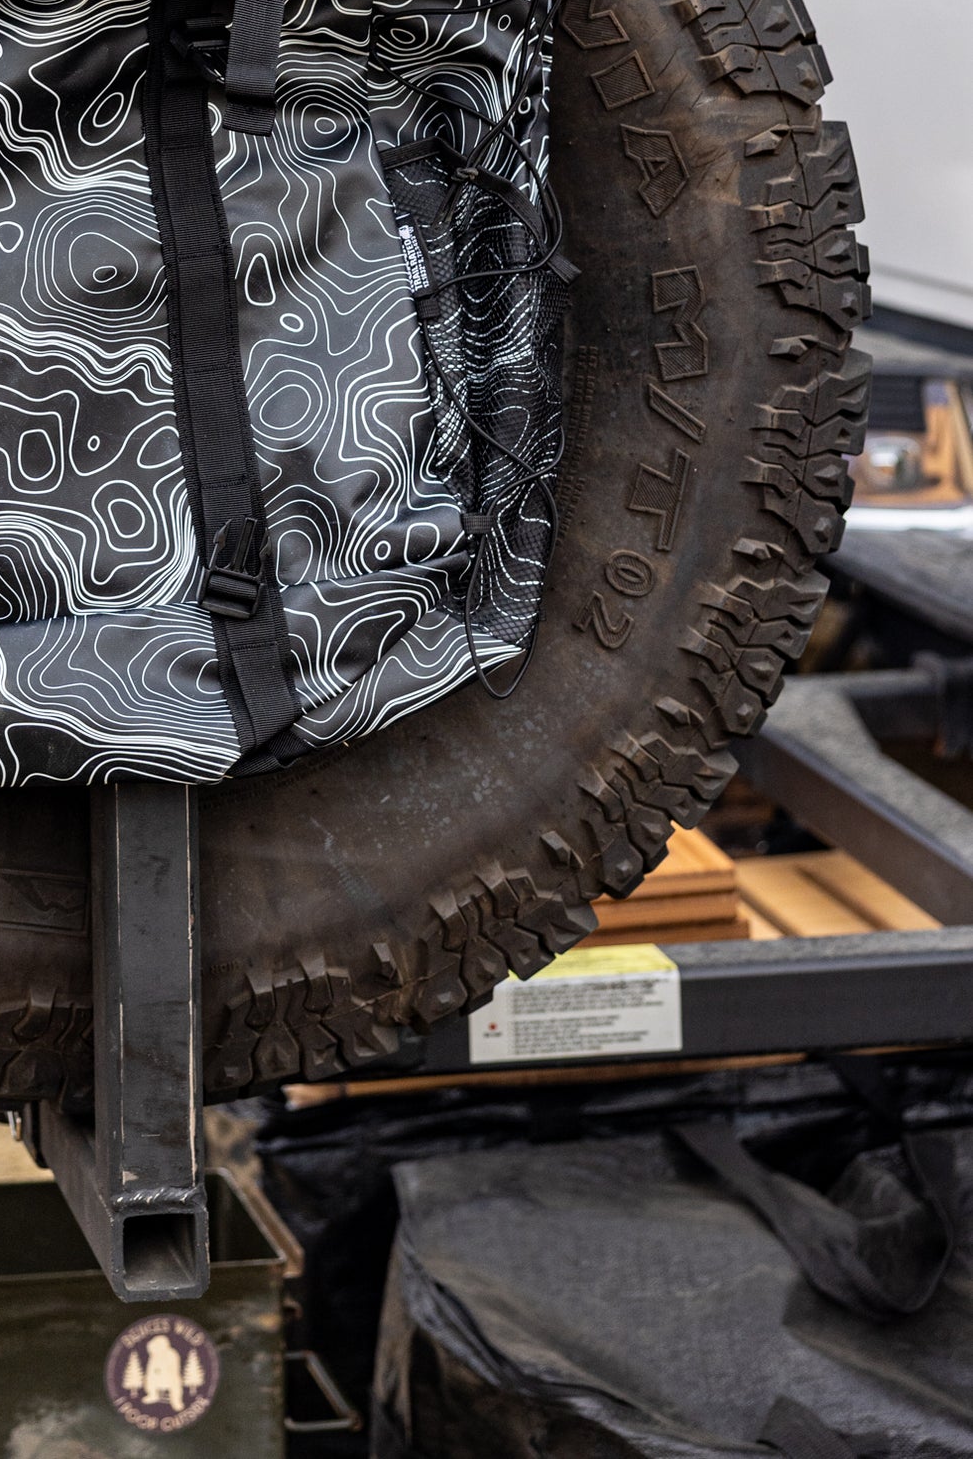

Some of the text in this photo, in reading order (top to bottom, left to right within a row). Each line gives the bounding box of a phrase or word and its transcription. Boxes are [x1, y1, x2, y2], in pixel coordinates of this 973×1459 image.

[403, 239, 418, 266] RATED
[411, 265, 423, 291] TRAIL
[627, 265, 710, 552] M/T
[572, 548, 657, 649] 02
